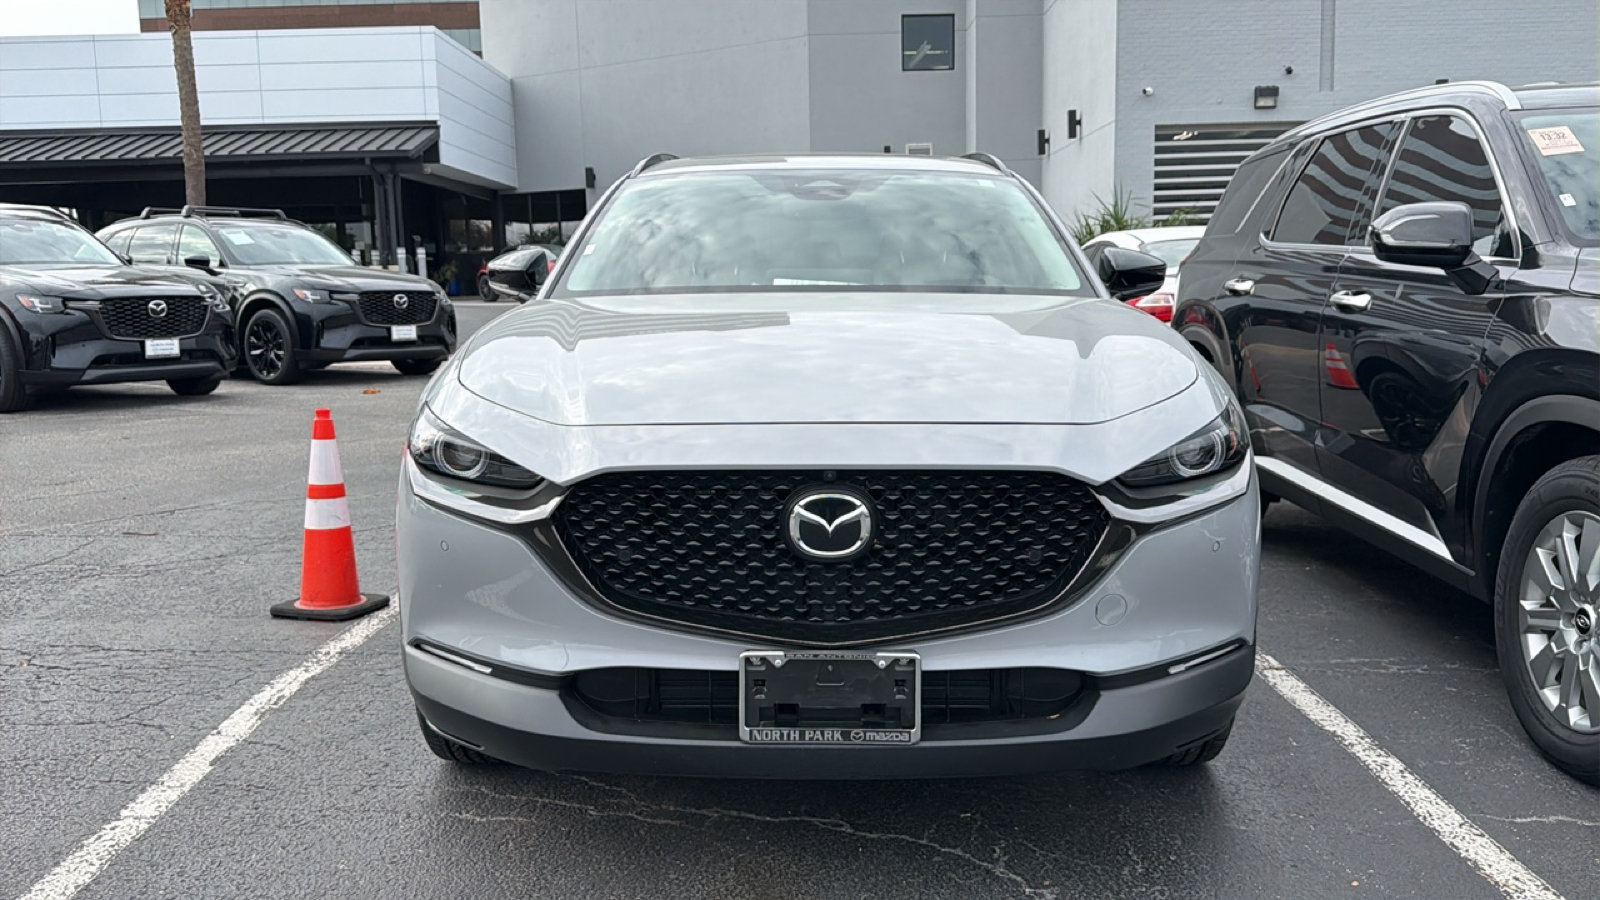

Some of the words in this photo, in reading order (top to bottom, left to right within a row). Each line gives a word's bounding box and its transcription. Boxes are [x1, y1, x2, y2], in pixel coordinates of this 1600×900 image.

[751, 729, 800, 742] NORTH
[804, 729, 844, 742] PARK
[865, 731, 910, 742] mazda
